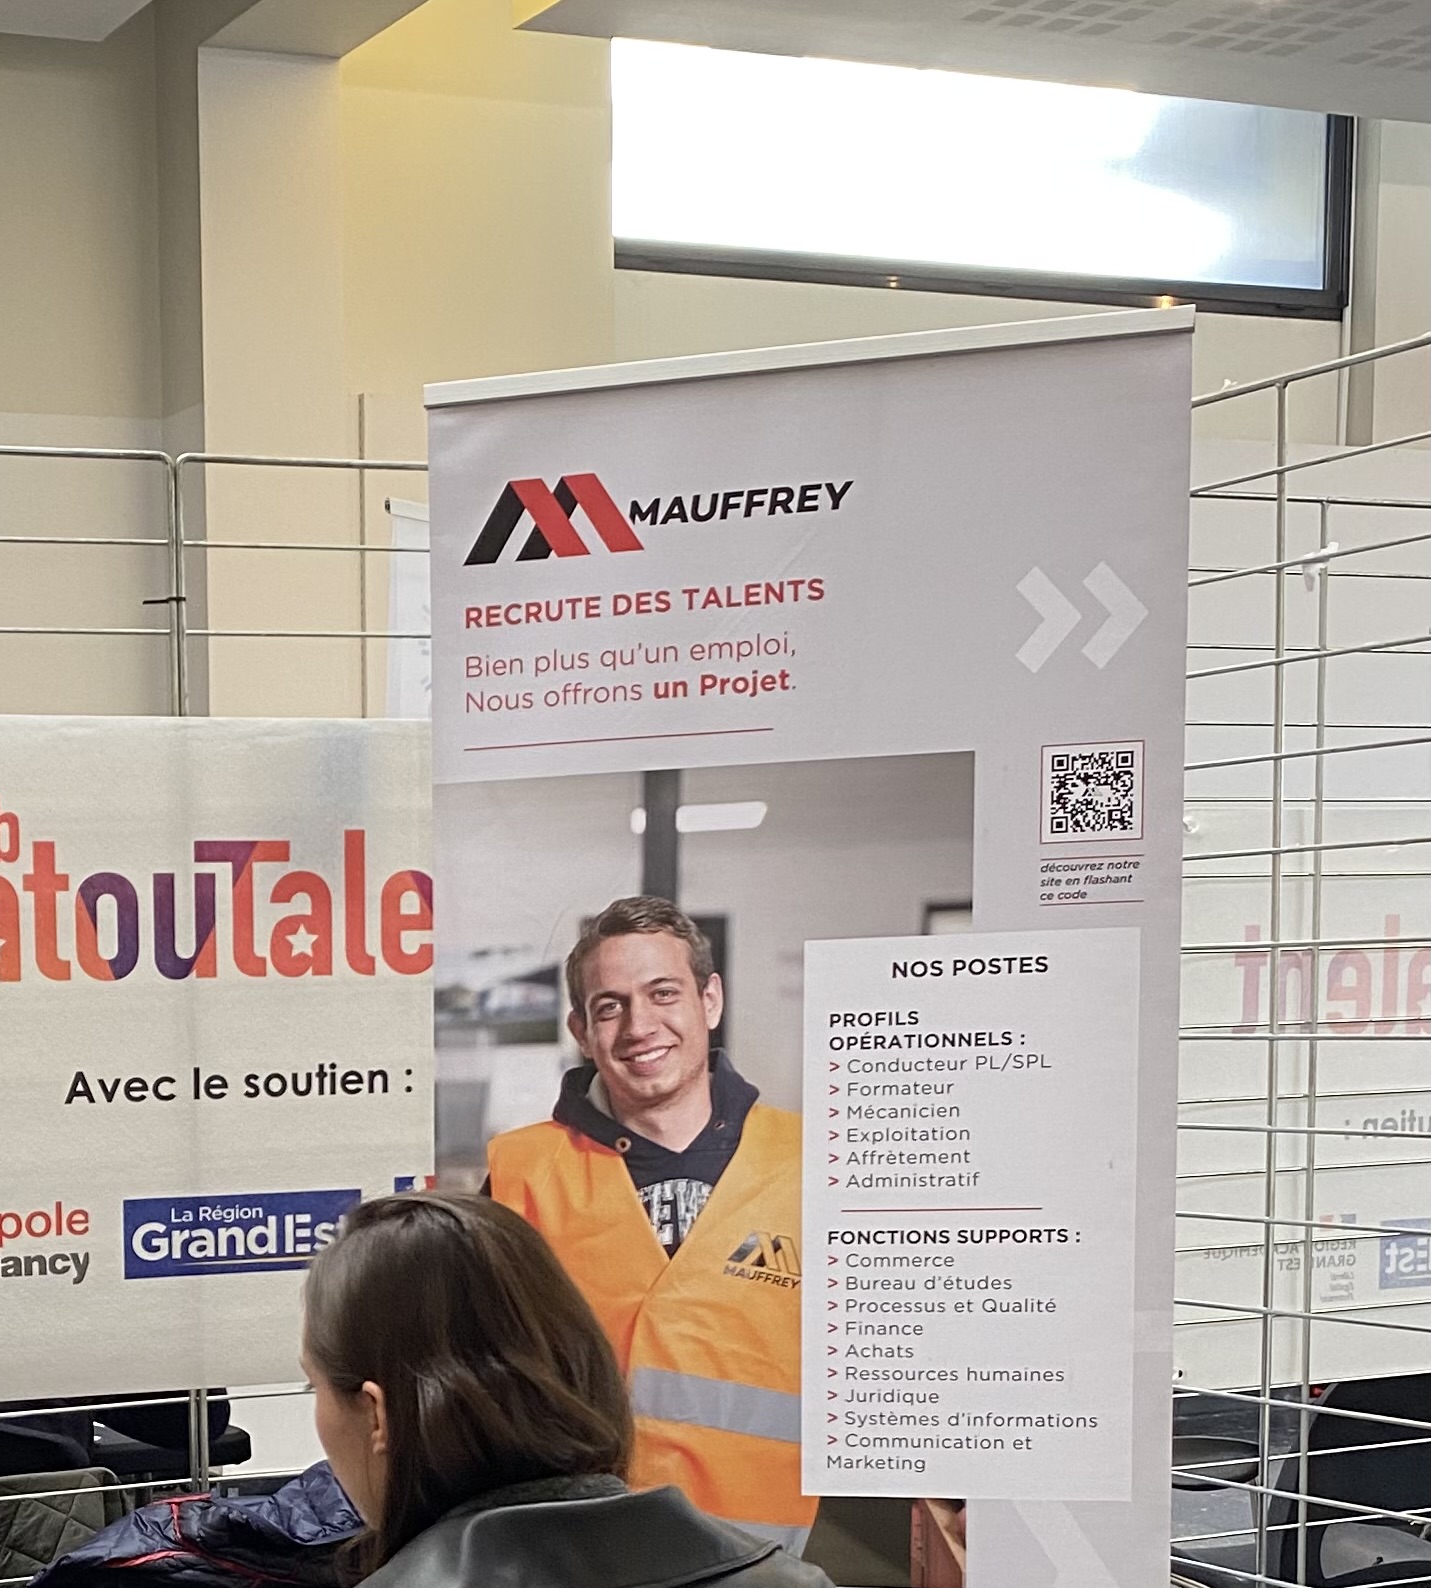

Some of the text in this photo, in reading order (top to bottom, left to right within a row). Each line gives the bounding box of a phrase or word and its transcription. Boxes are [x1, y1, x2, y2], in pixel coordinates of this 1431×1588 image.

[628, 480, 854, 527] MAUFFREY
[464, 577, 825, 630] RECRUTE DES TALENTS
[464, 632, 797, 680] Bien plus qu'un emploi,
[464, 669, 797, 715] Nous offrons un Projet.
[1040, 860, 1141, 874] découvrez notre
[1039, 874, 1133, 888] site en flashant
[1039, 890, 1088, 901] ce code
[891, 956, 1049, 979] NOS POSTES
[829, 1010, 920, 1028] PROFILS
[829, 1031, 1014, 1051] OPÉRATIONNELS
[847, 1053, 1053, 1075] Conducteur PL/SPL
[64, 1070, 177, 1104] Avec
[192, 1066, 229, 1100] le
[243, 1062, 390, 1099] soutien
[846, 1080, 955, 1098] Formateur
[846, 1103, 961, 1121] Mécanicien
[846, 1126, 971, 1146] Exploitation
[846, 1171, 981, 1189] Administratif
[171, 1203, 264, 1223] La Région
[827, 1229, 951, 1246] FONCTIONS
[957, 1228, 1069, 1244] SUPPORTS
[845, 1253, 955, 1268] Commerce
[845, 1275, 916, 1291] Bureau
[845, 1298, 1058, 1315] Processus et Qualité
[845, 1321, 924, 1336] Finance
[844, 1344, 915, 1359] Achats
[845, 1366, 1066, 1383] Ressources humaines
[844, 1389, 940, 1406] Juridique
[844, 1411, 940, 1429] Systèmes
[844, 1433, 1033, 1450] Communication et
[827, 1455, 927, 1473] Marketing
